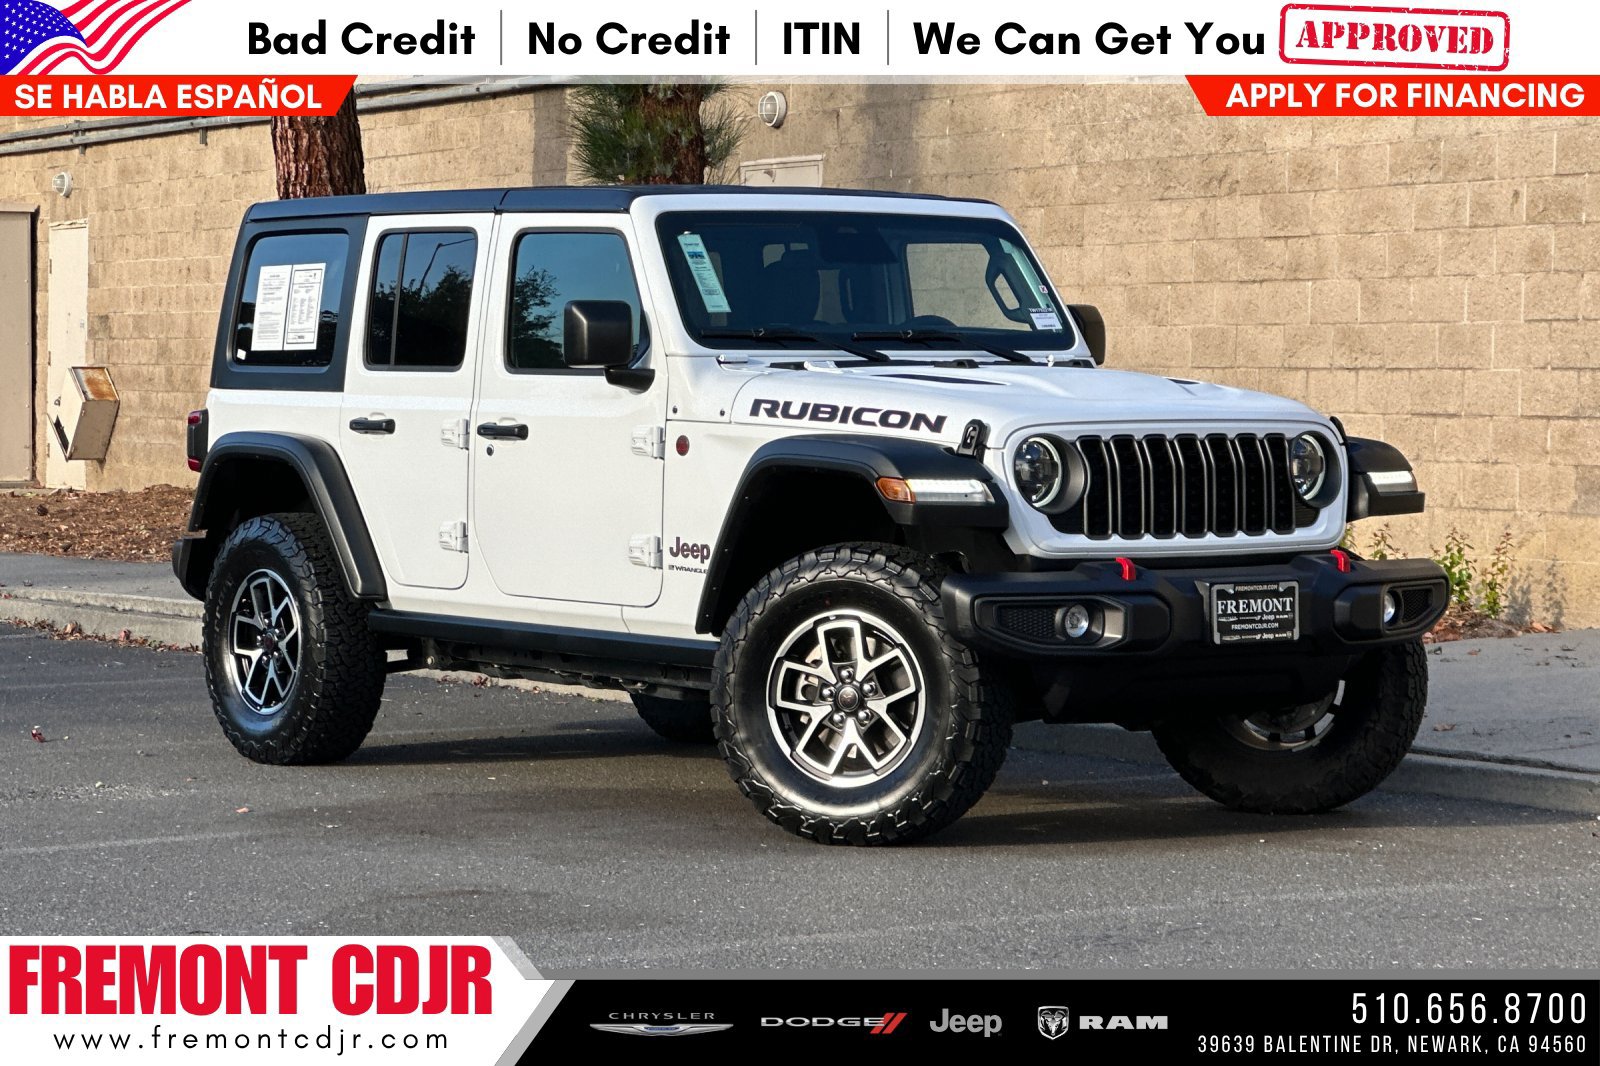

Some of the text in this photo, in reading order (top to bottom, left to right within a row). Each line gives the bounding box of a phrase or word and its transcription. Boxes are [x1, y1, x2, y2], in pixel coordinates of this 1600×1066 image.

[749, 398, 948, 433] RUBICON
[669, 536, 711, 565] Jeep
[674, 564, 710, 575] WRANGLE
[1217, 597, 1293, 614] FREMONT
